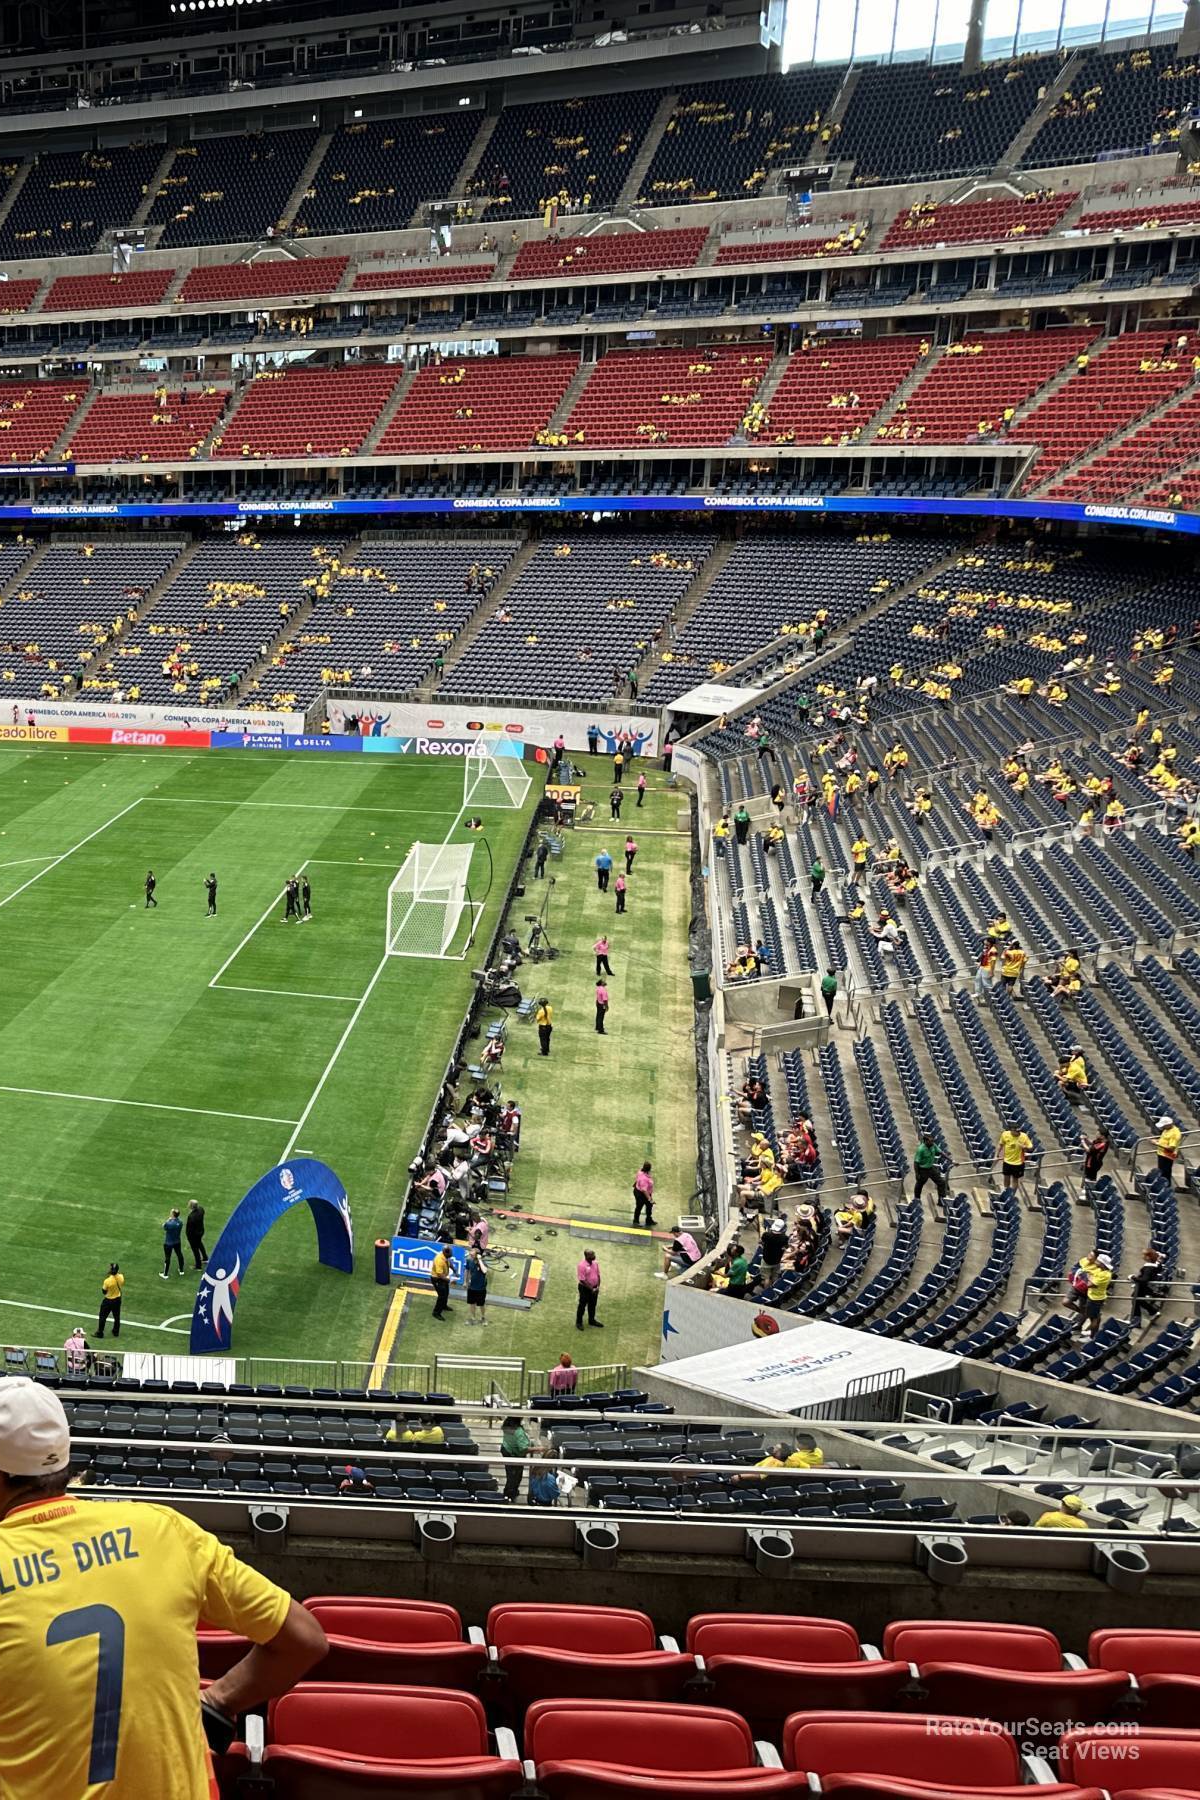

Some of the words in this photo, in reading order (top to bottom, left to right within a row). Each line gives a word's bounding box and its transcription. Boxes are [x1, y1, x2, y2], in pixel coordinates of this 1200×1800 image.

[239, 503, 279, 511] CONMEBOL
[300, 502, 334, 510] AMERICA
[454, 500, 499, 508] CONMEBOL
[500, 500, 523, 508] COPA
[524, 499, 560, 507] AMERICA
[704, 498, 756, 506] CONMEBOL
[757, 498, 782, 506] COPA
[783, 498, 824, 506] AMERICA
[1085, 506, 1129, 518] CONMEBOL
[1130, 508, 1147, 520] COPA
[1146, 510, 1175, 524] AMERICA
[60, 710, 77, 718] COPA
[79, 711, 106, 719] AMERICA
[29, 728, 57, 740] libre
[112, 729, 166, 745] Betano
[416, 737, 487, 756] Rexona
[32, 1505, 77, 1525] COLOMBIA
[72, 1527, 139, 1573] DIAZ
[46, 1604, 125, 1784] 7
